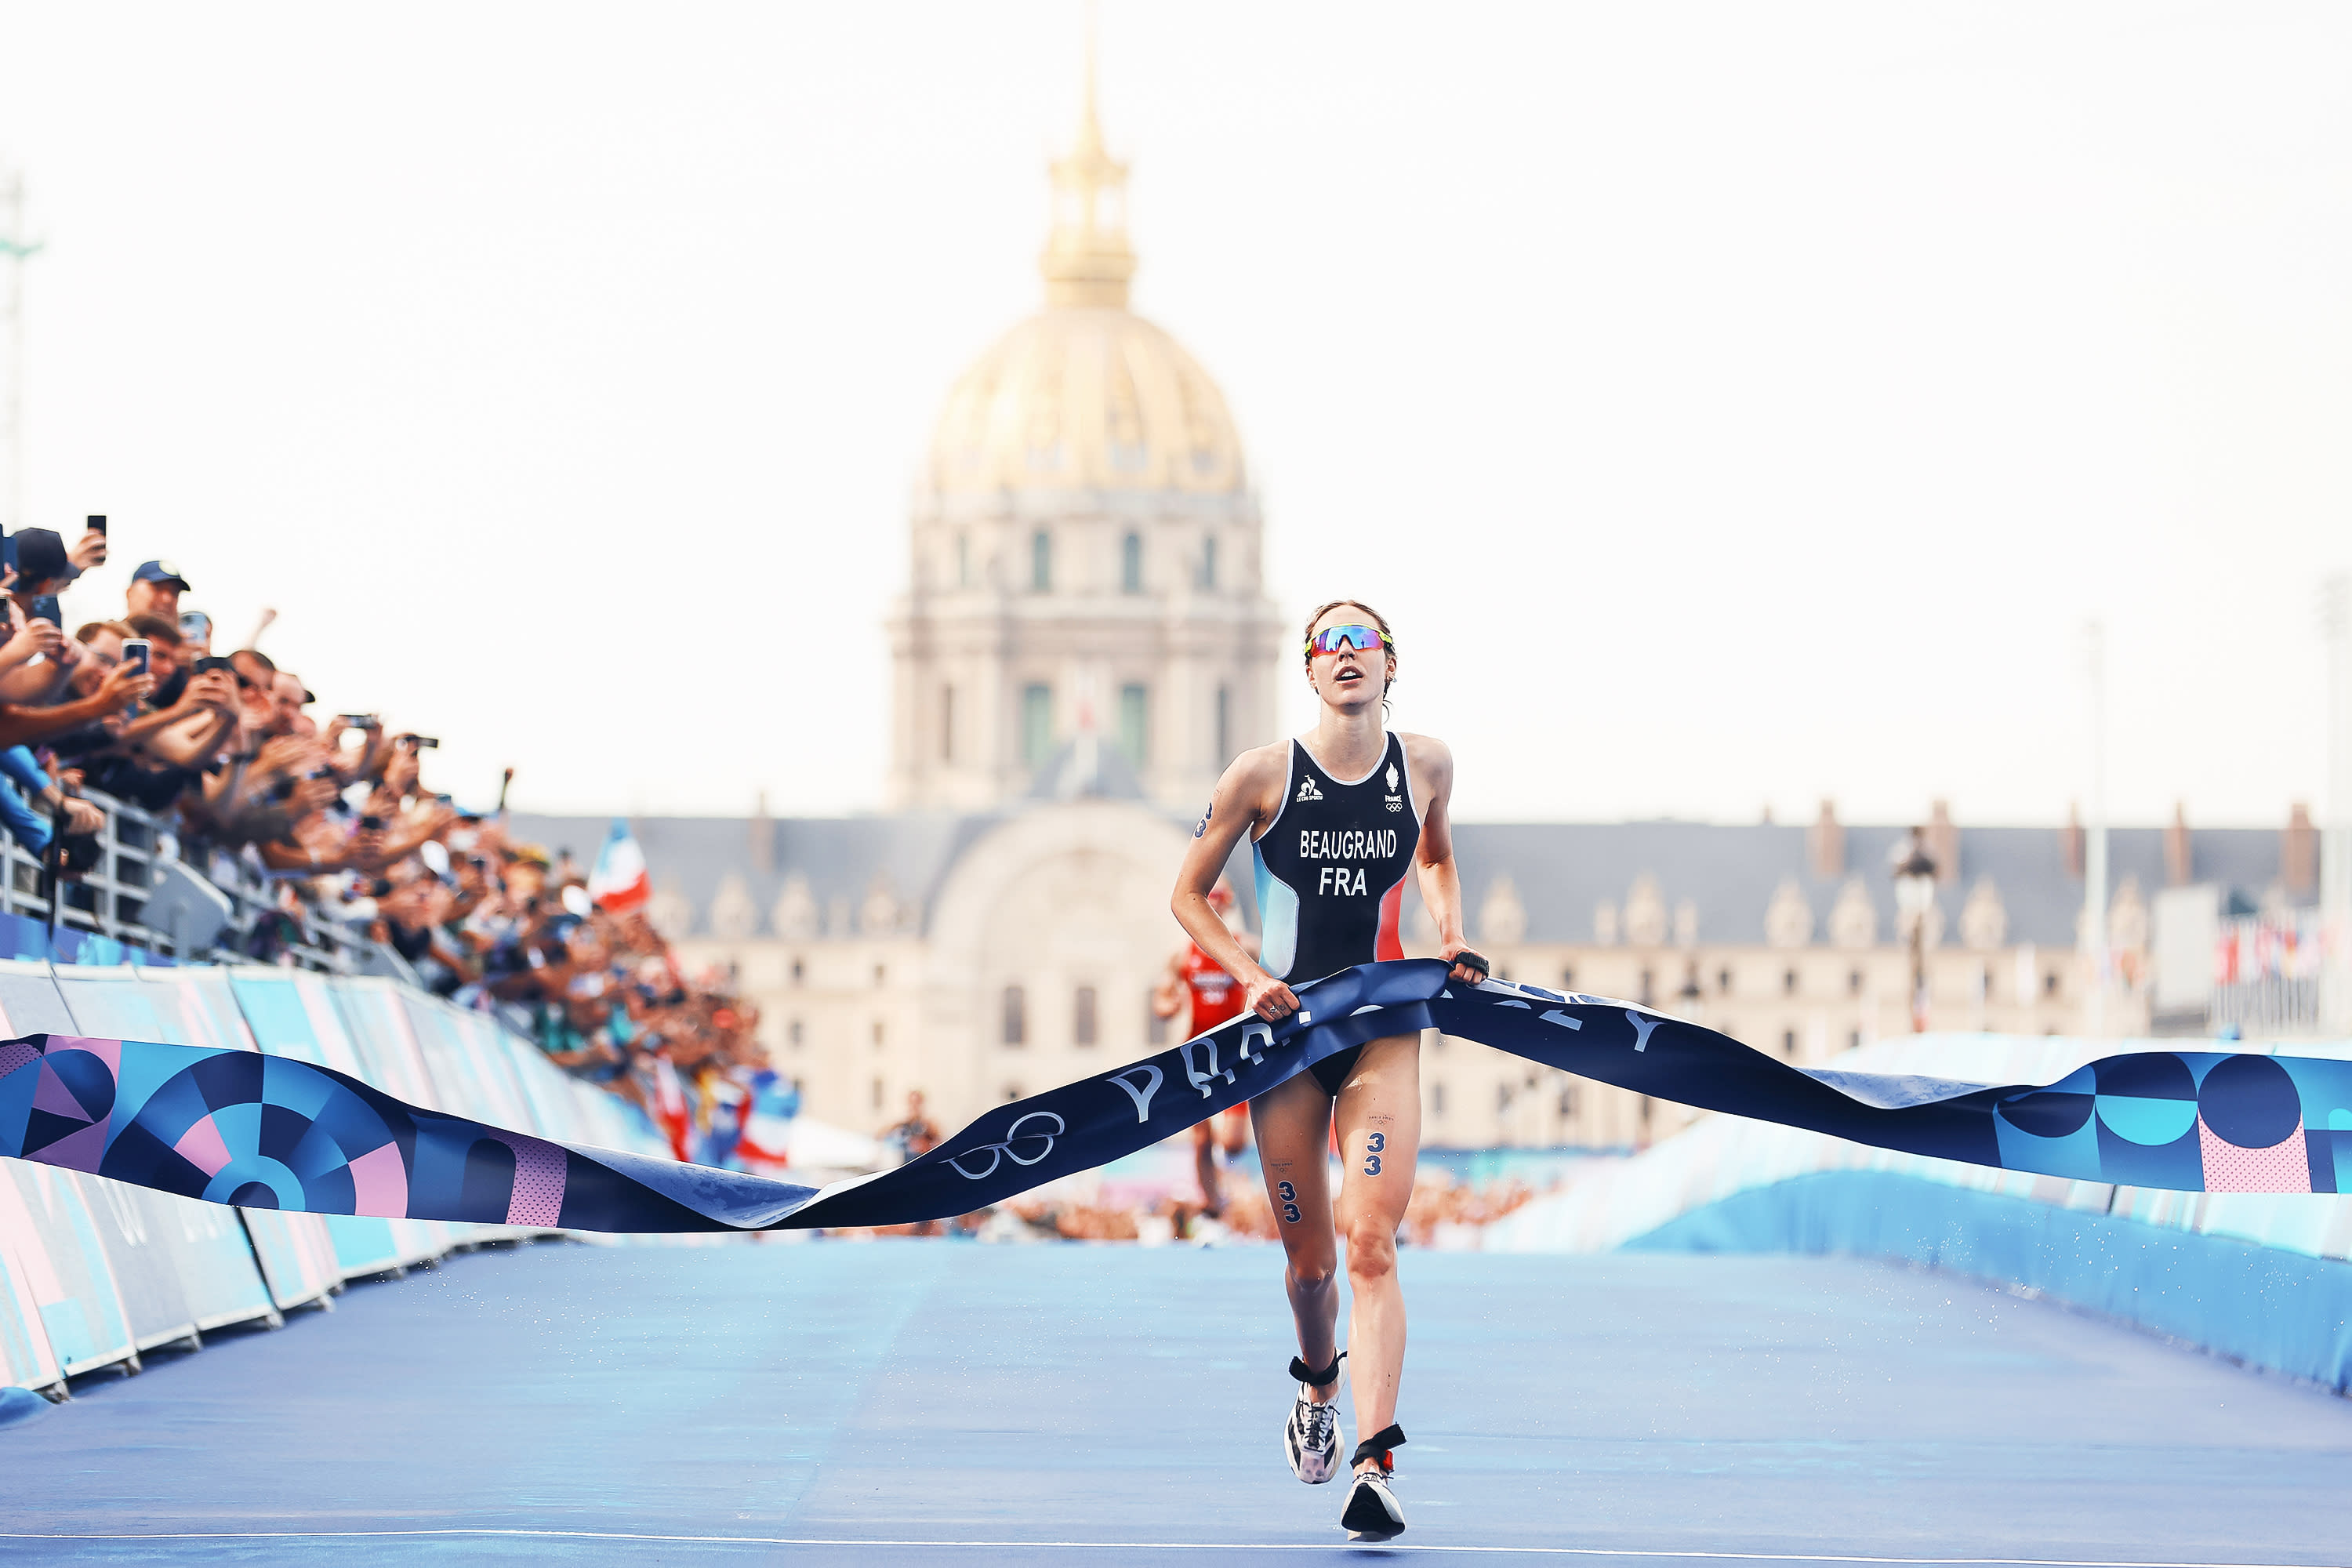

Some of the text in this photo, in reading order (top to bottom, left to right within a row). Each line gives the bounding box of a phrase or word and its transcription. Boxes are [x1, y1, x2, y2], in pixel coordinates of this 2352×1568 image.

[1385, 794, 1402, 803] FRANCE
[1300, 829, 1397, 859] BEAUGRAND
[1319, 867, 1367, 896] FRA
